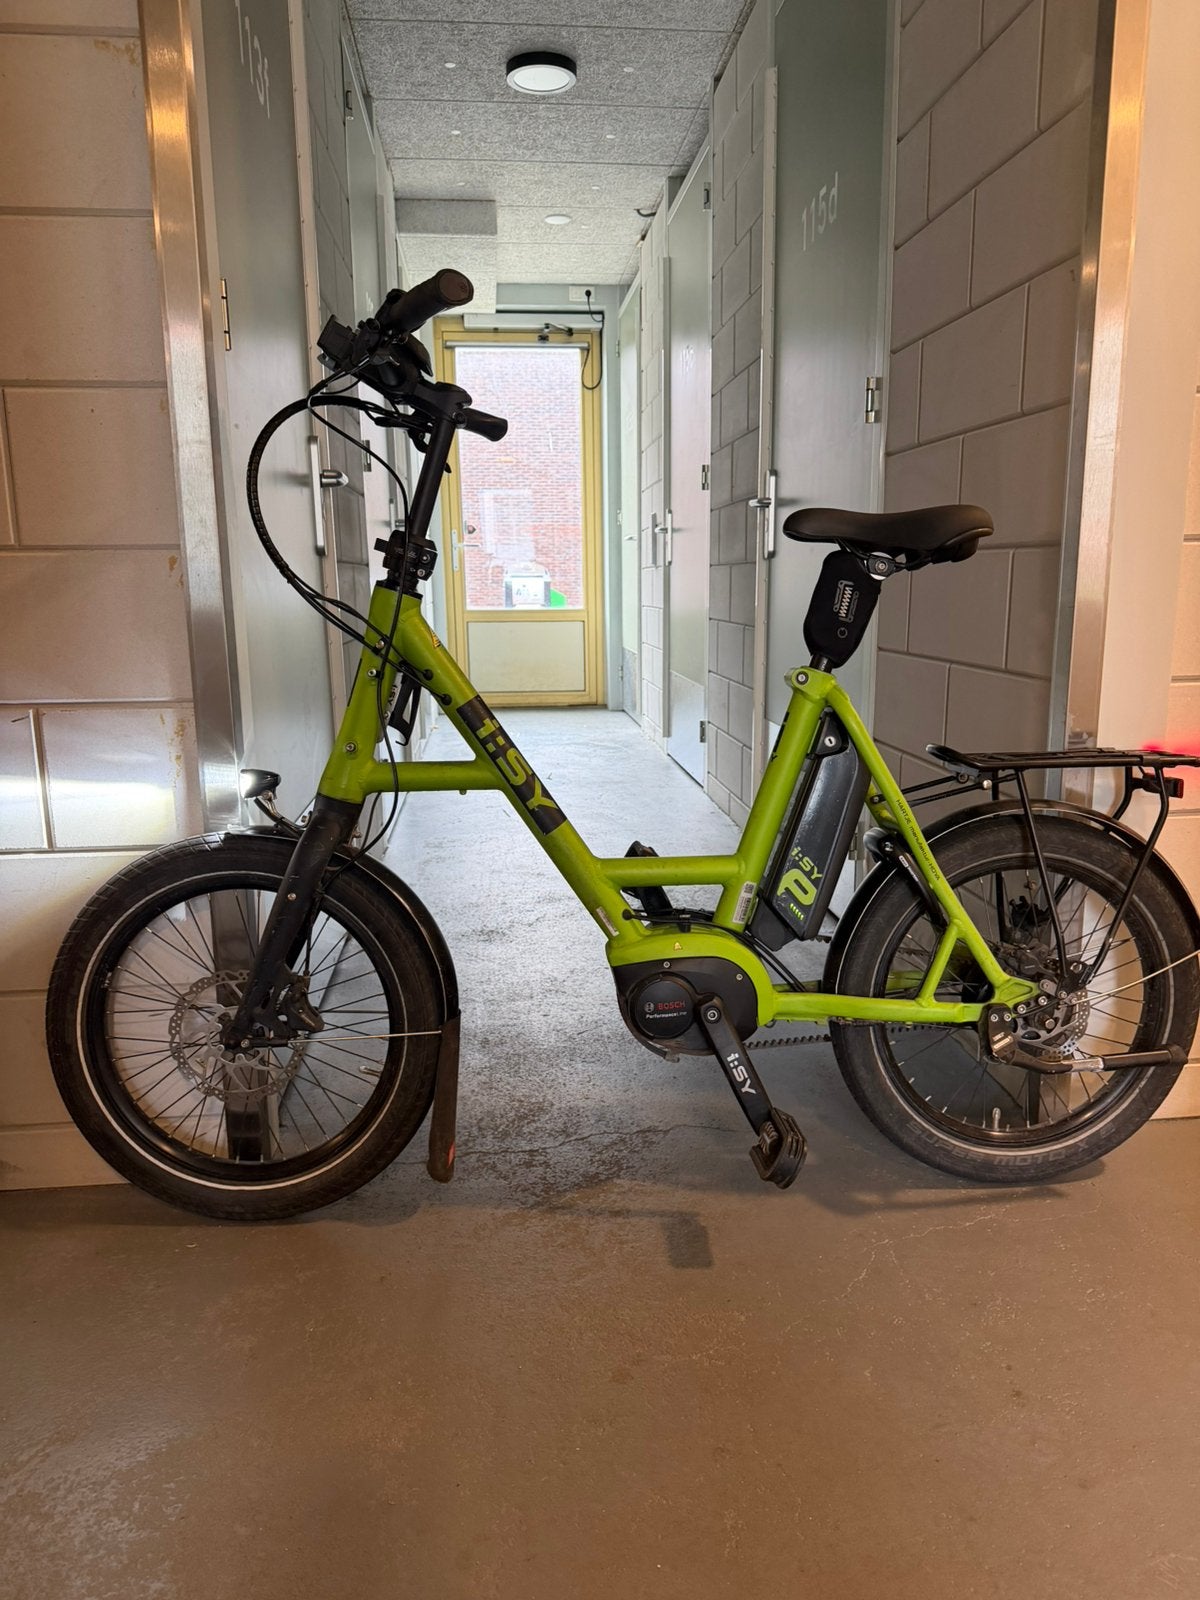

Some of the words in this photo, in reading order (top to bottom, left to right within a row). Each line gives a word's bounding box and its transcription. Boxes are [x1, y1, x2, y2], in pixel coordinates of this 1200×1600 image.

[801, 170, 839, 252] 115d
[475, 717, 560, 811] i:SY
[791, 846, 823, 880] i:SY
[656, 1000, 686, 1011] BOSCH
[726, 1052, 757, 1095] i:SY
